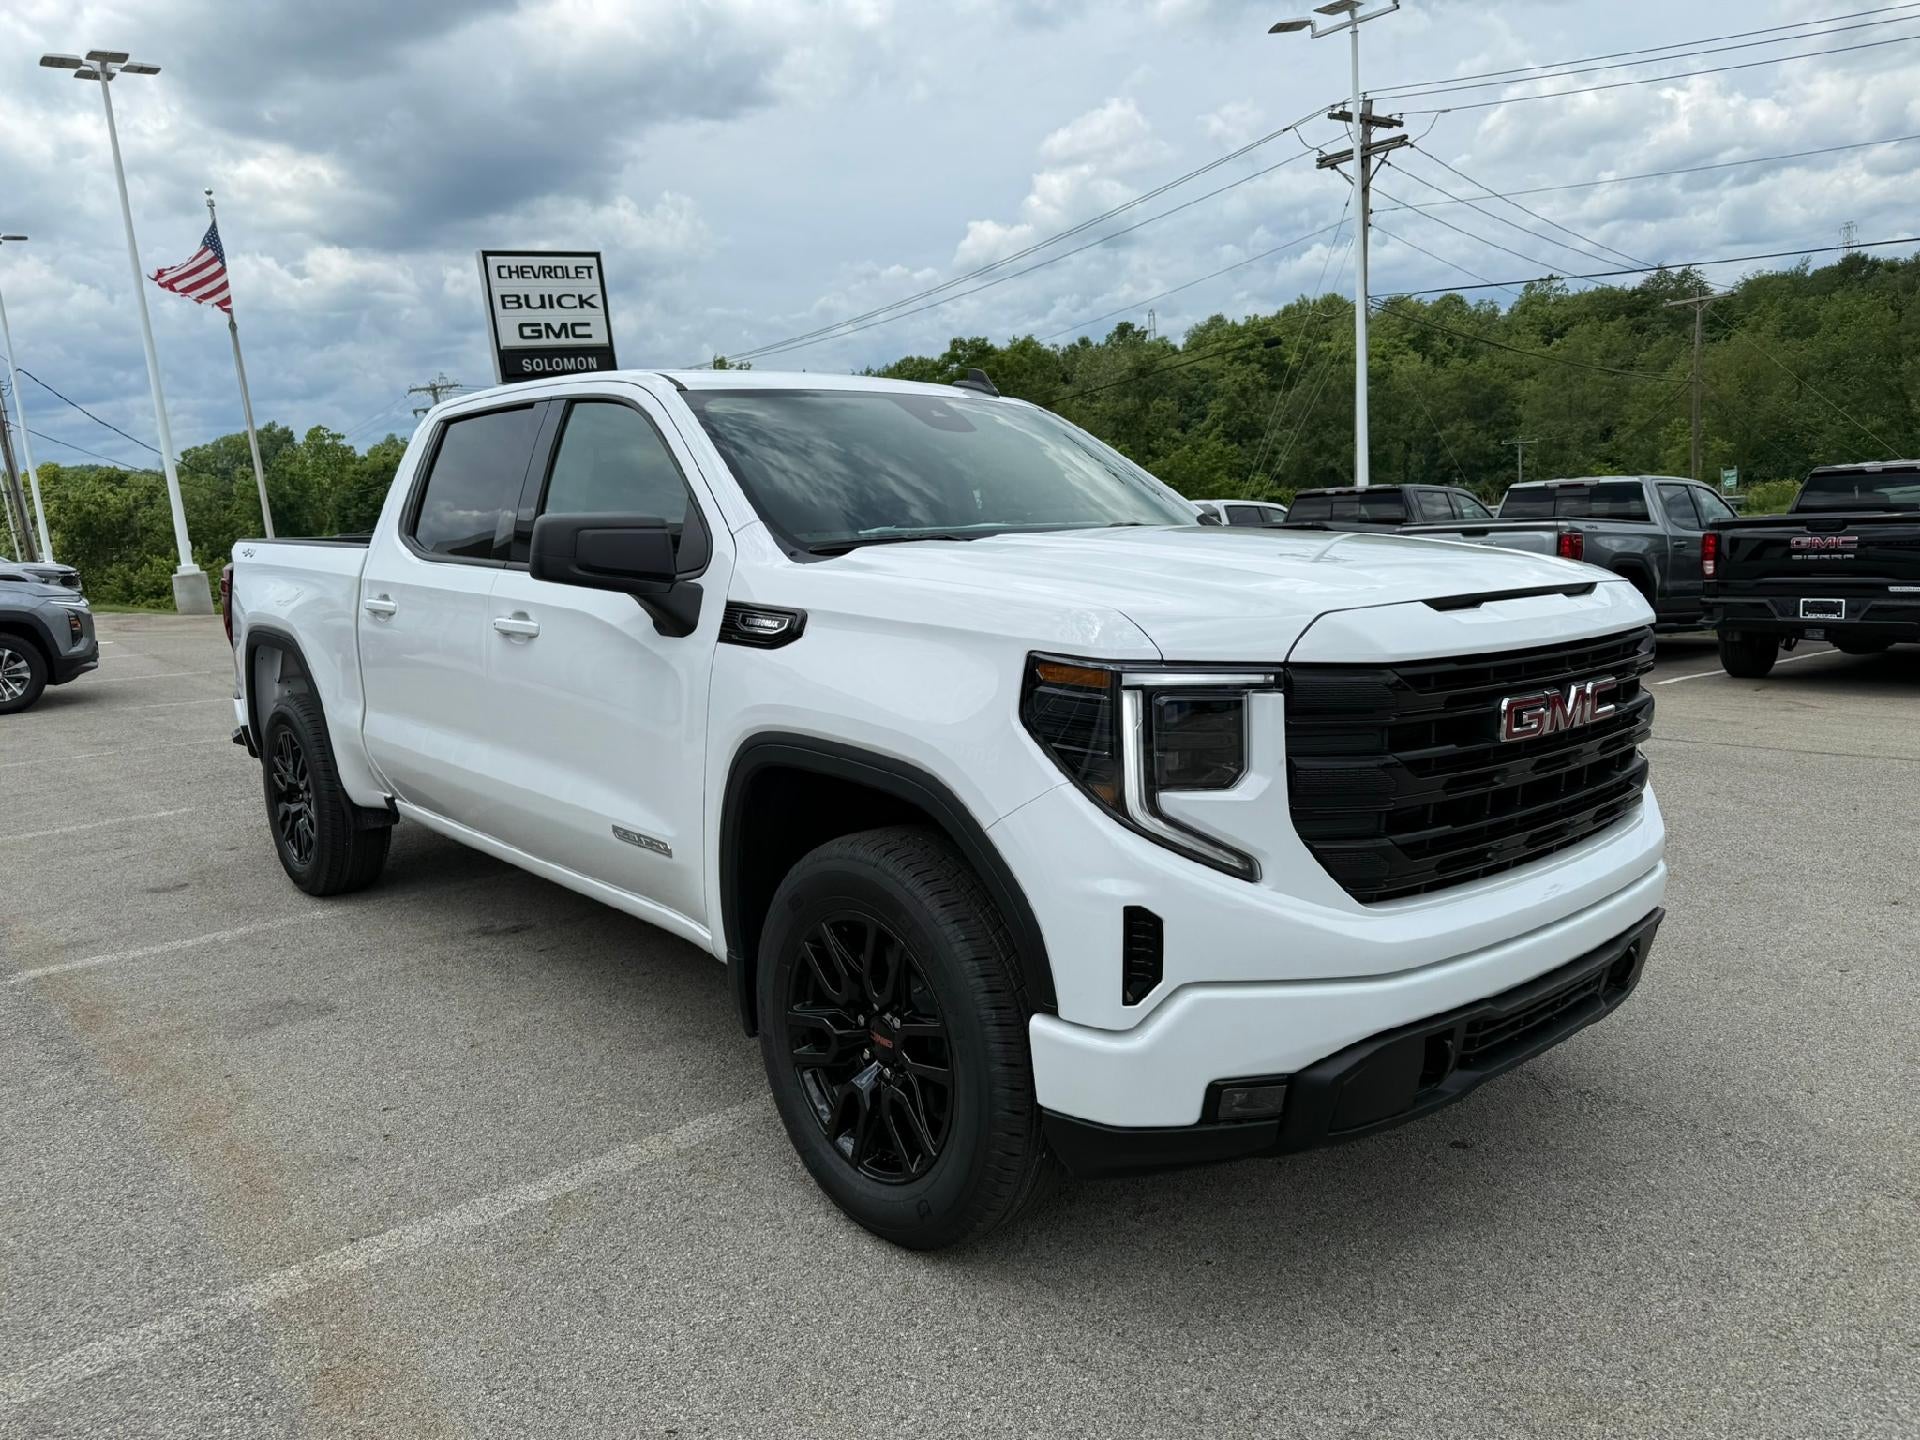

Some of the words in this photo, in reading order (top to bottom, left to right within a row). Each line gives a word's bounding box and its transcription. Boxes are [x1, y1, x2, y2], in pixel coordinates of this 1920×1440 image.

[496, 265, 594, 280] CHEVROLET
[500, 293, 600, 310] BUICK
[518, 322, 593, 340] GMC
[522, 356, 598, 372] SOLOMON
[1790, 536, 1858, 549] GMC
[1499, 675, 1617, 743] GMC
